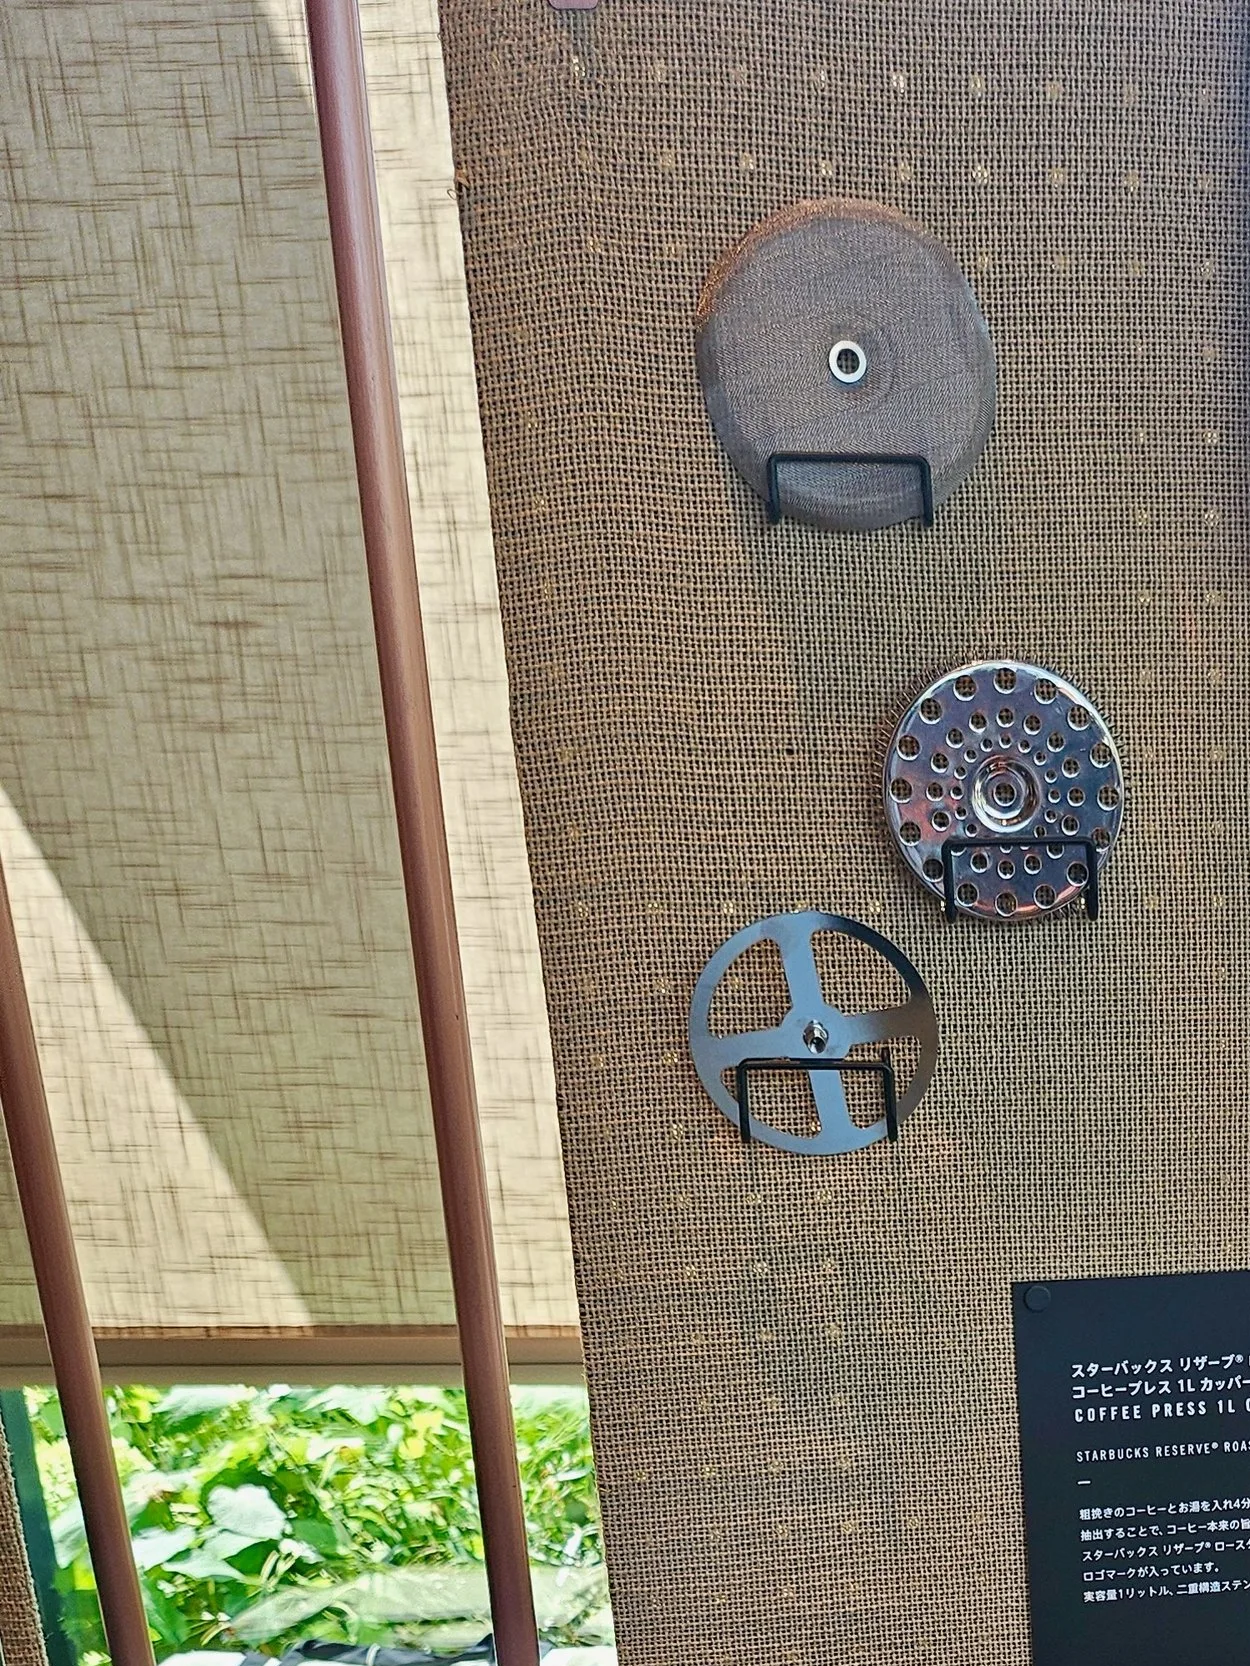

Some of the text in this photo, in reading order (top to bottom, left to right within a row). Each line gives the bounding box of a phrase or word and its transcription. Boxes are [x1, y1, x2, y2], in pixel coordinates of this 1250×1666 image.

[1071, 1358, 1173, 1378] スターバックス
[1178, 1378, 1195, 1393] 1L
[1074, 1405, 1142, 1422] COFFEE
[1152, 1401, 1206, 1418] PRESS
[1217, 1399, 1236, 1414] 1L
[1076, 1447, 1149, 1463] STARBUCKS
